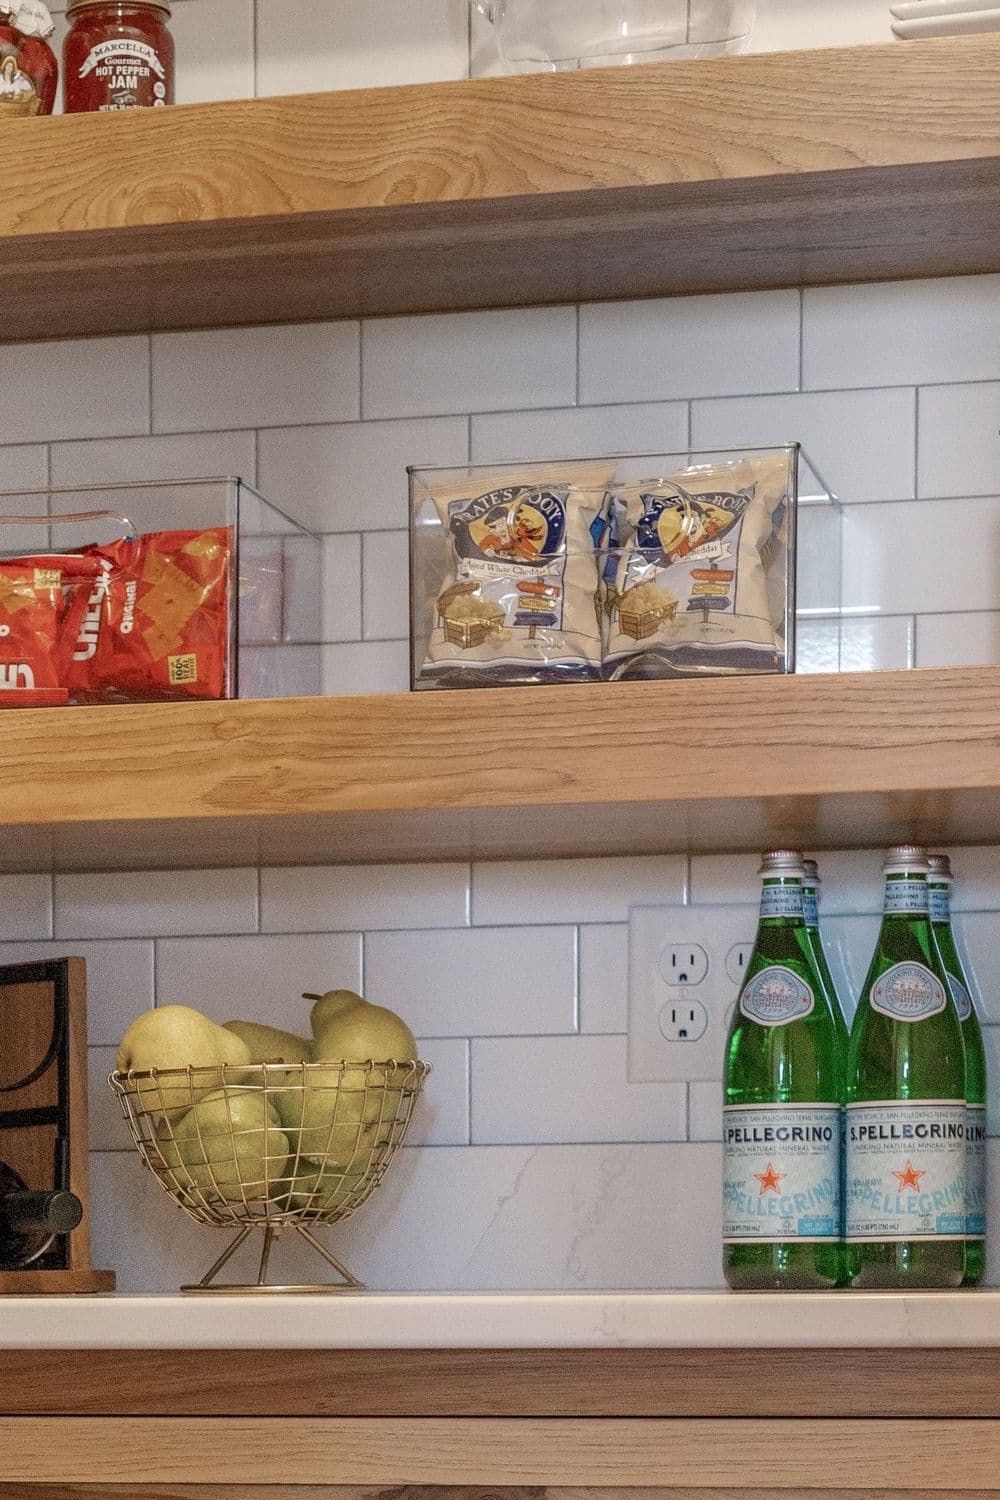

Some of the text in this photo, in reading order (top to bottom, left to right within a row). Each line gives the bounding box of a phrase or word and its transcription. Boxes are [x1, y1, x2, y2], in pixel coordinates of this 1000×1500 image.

[94, 43, 152, 57] MARCELLA
[104, 57, 142, 66] Gourmet
[95, 66, 150, 77] HOT PEPPER
[108, 75, 138, 89] JAM
[850, 1123, 964, 1141] S.PELLEGRINO
